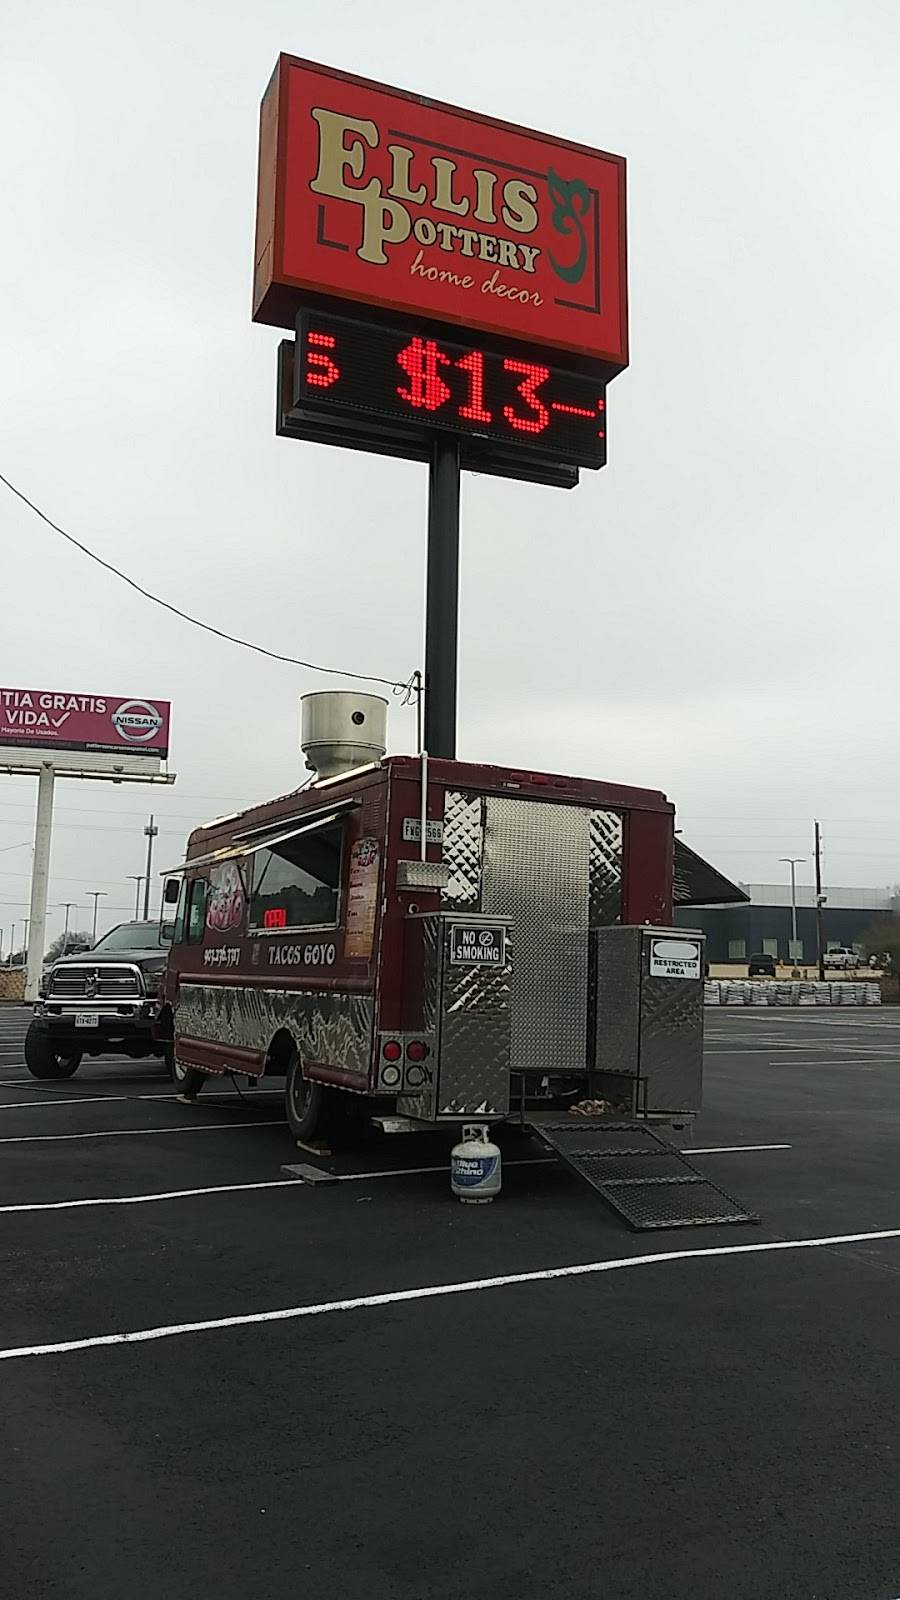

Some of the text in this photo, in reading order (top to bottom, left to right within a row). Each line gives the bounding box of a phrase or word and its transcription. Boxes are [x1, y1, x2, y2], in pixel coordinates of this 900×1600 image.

[309, 106, 539, 233] ELLIS
[356, 197, 542, 273] POTTERY
[410, 250, 544, 307] home decor
[39, 693, 107, 714] GRATIS
[5, 709, 50, 727] VIDA
[116, 716, 159, 726] NISSAN
[462, 930, 476, 945] NO
[268, 945, 301, 965] TACOS
[303, 944, 336, 966] GOYO
[456, 945, 500, 961] SMOKING
[653, 959, 697, 969] RESTRICTED
[665, 967, 686, 975] AREA
